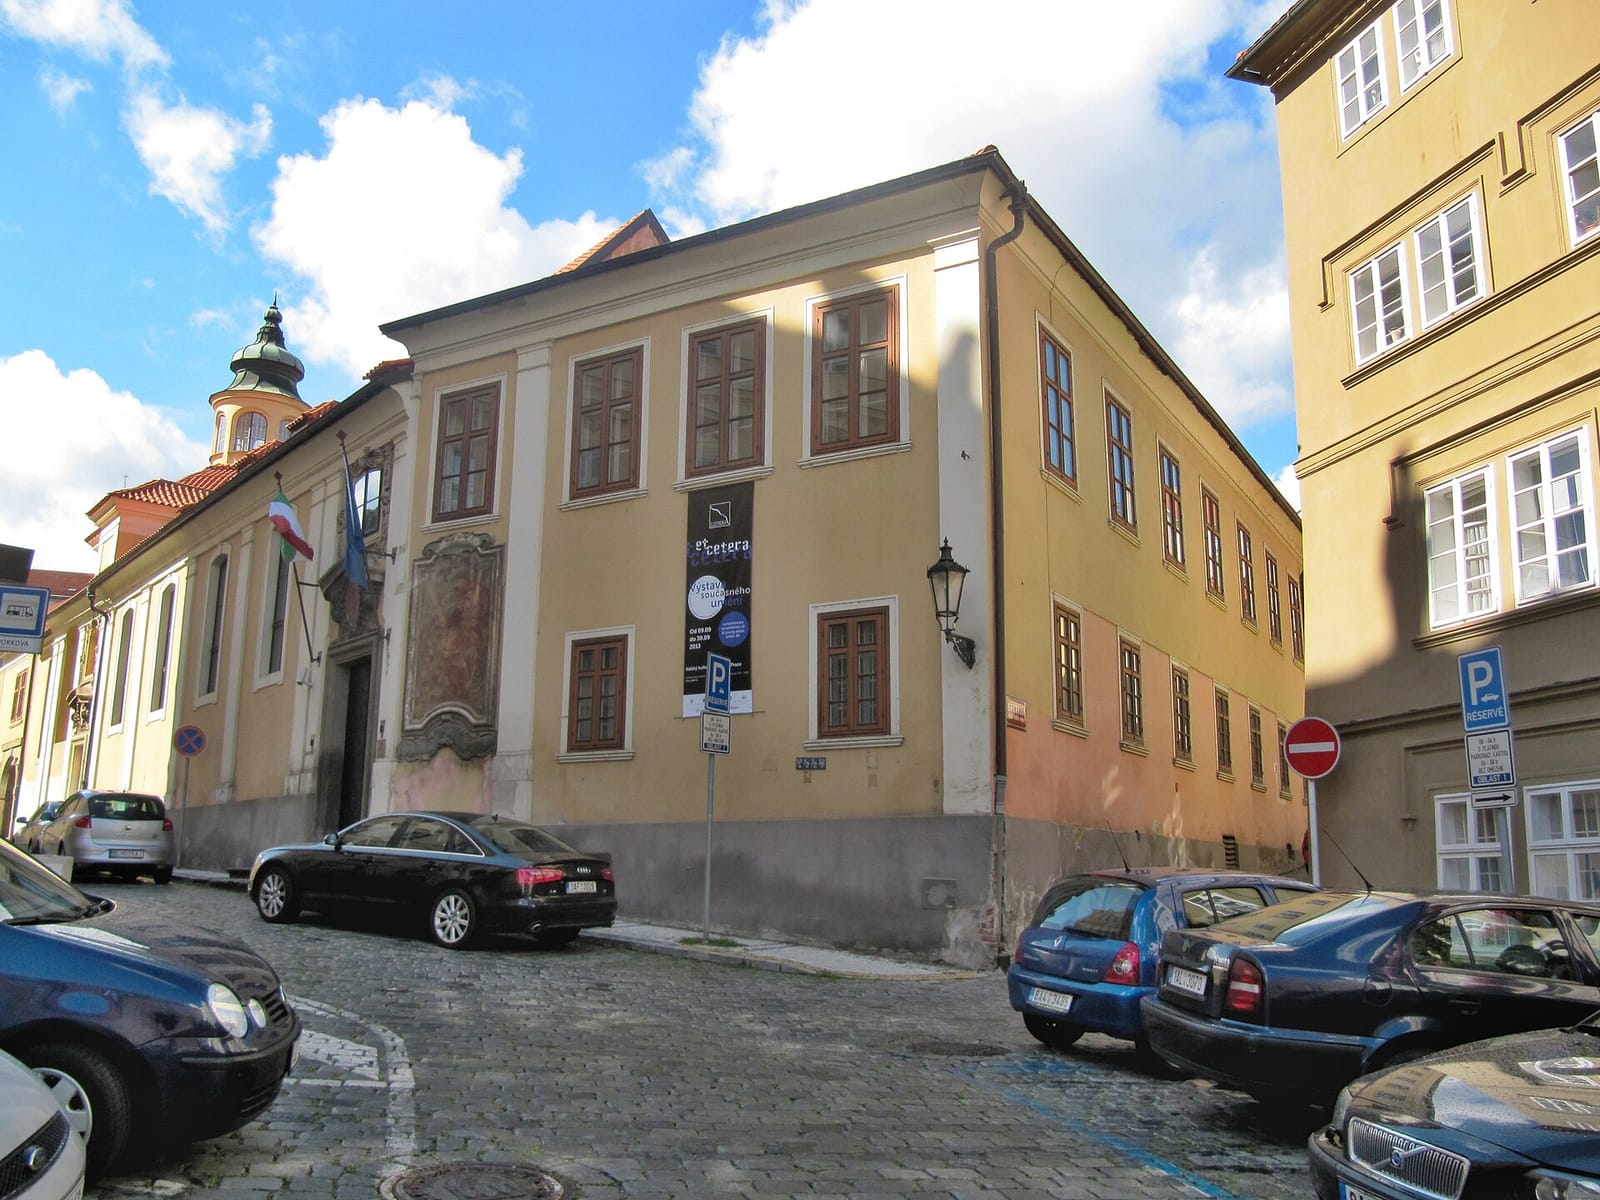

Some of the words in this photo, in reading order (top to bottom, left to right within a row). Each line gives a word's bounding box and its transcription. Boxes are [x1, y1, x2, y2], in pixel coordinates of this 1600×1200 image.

[0, 639, 29, 647] ORKOVA
[712, 661, 726, 693] P
[1467, 660, 1493, 706] P
[1466, 706, 1505, 721] RÉSERVÉ
